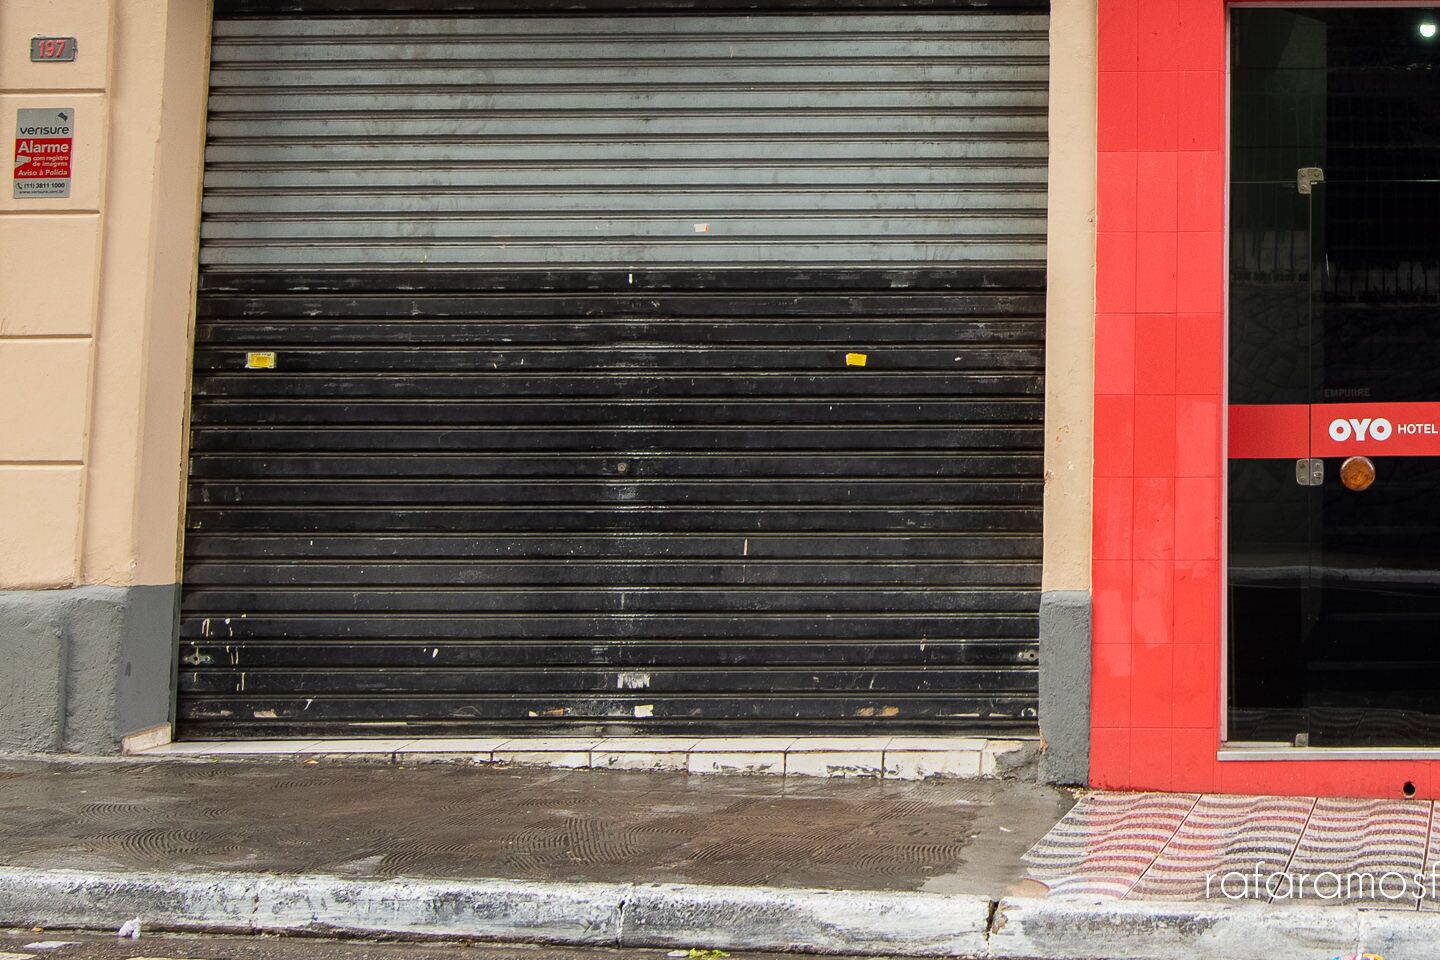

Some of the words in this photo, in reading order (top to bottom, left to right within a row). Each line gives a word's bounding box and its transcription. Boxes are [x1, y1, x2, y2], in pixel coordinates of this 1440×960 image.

[38, 40, 65, 58] 197
[19, 125, 69, 135] verisure
[18, 141, 69, 154] Alarme
[46, 155, 69, 163] registro
[1328, 417, 1393, 441] OYO
[1397, 423, 1438, 434] HOTEL
